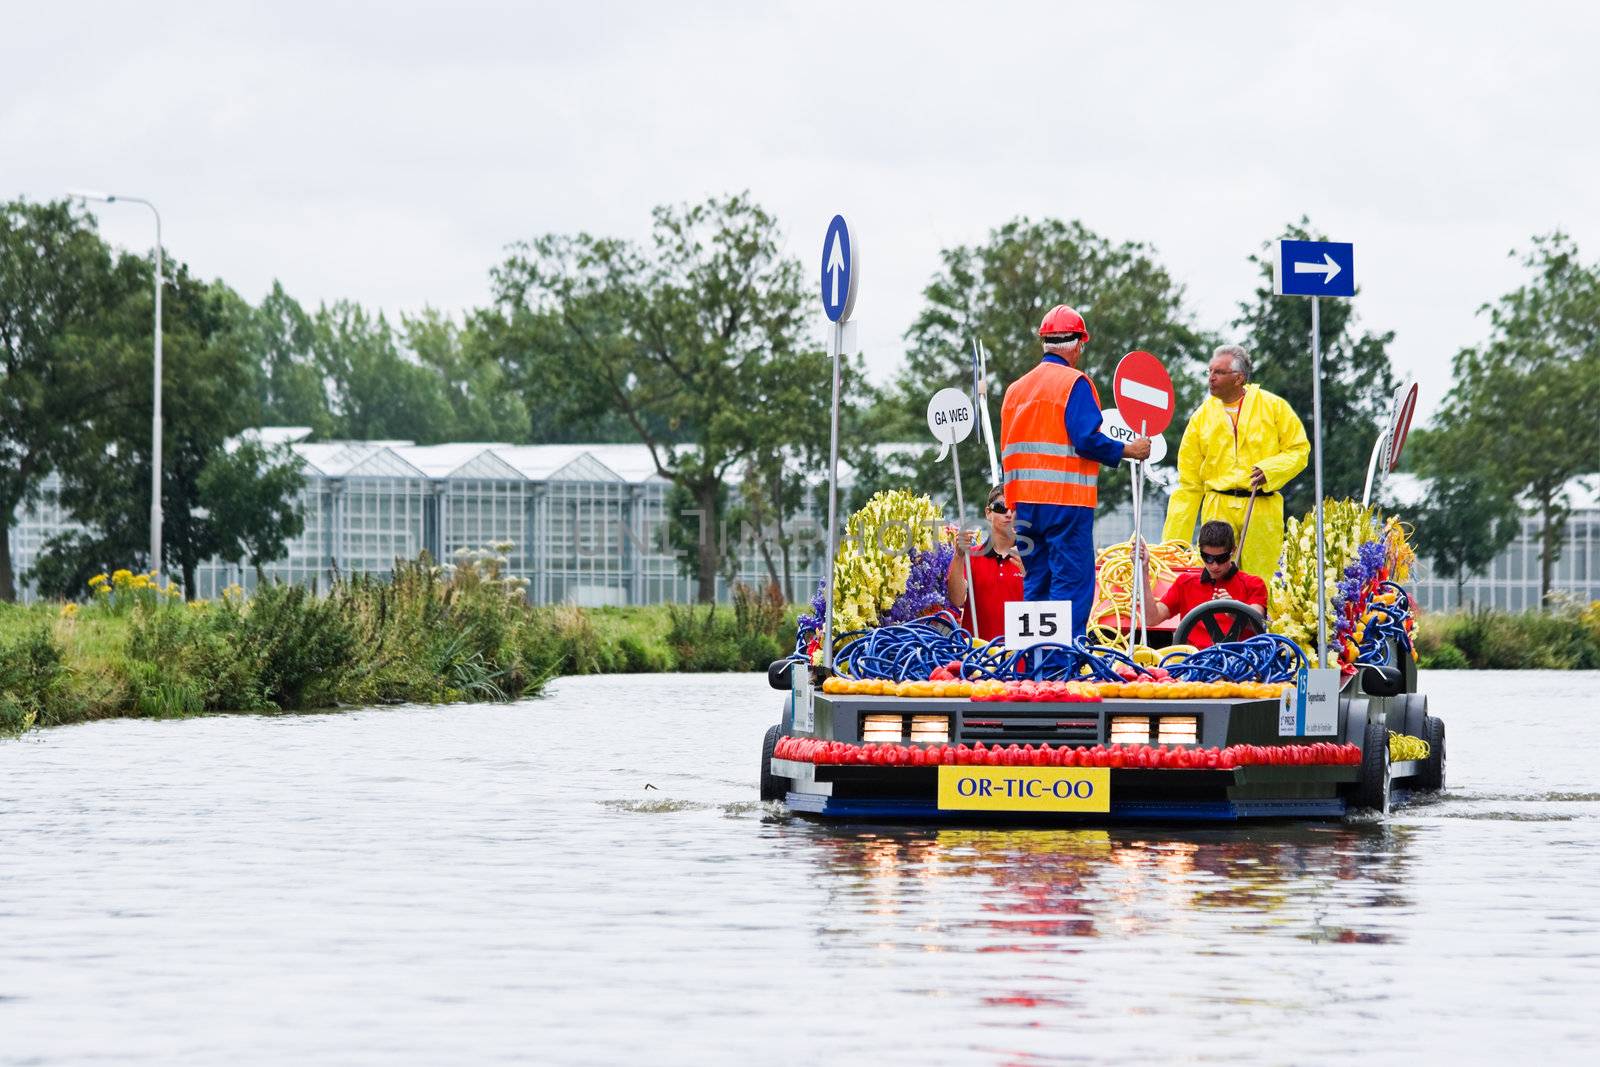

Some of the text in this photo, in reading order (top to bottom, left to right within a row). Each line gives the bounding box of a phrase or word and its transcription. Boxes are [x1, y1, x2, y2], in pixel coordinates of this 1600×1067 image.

[935, 407, 969, 425] GA WEG
[1018, 613, 1059, 637] 15
[1299, 674, 1307, 694] 15
[957, 778, 1094, 800] OR-TIC-OO
